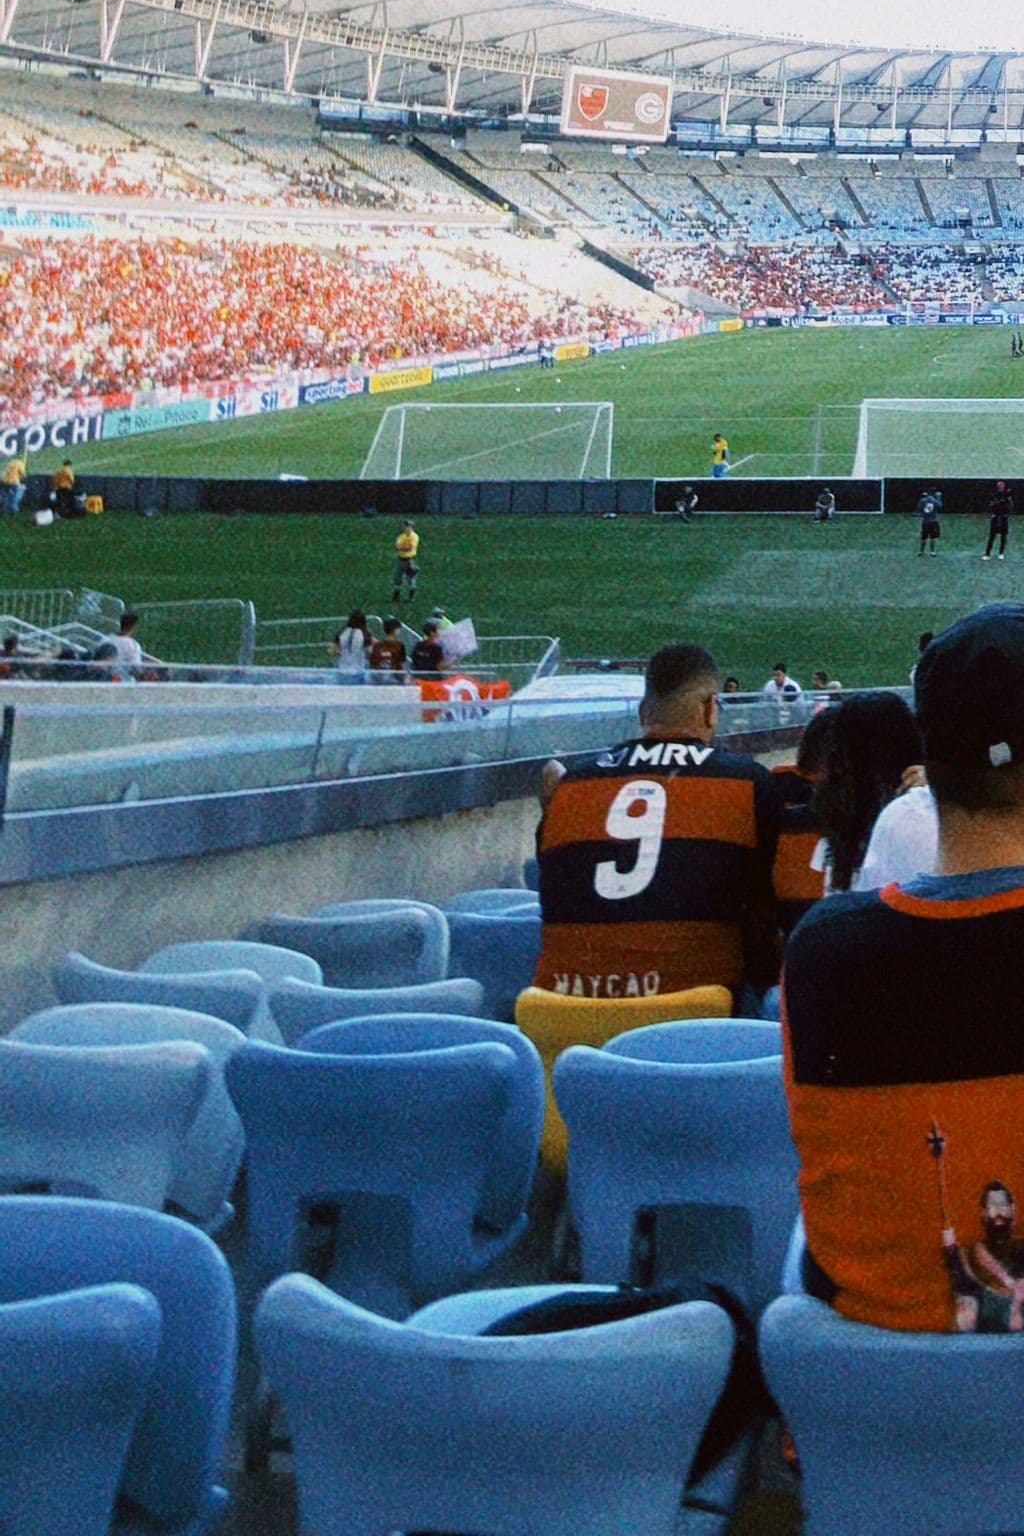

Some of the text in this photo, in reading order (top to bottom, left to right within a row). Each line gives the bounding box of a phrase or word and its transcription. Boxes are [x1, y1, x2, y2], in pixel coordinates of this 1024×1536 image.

[216, 395, 237, 419] Sil
[260, 390, 279, 413] Sil
[628, 743, 715, 767] MRV
[594, 779, 667, 901] 9
